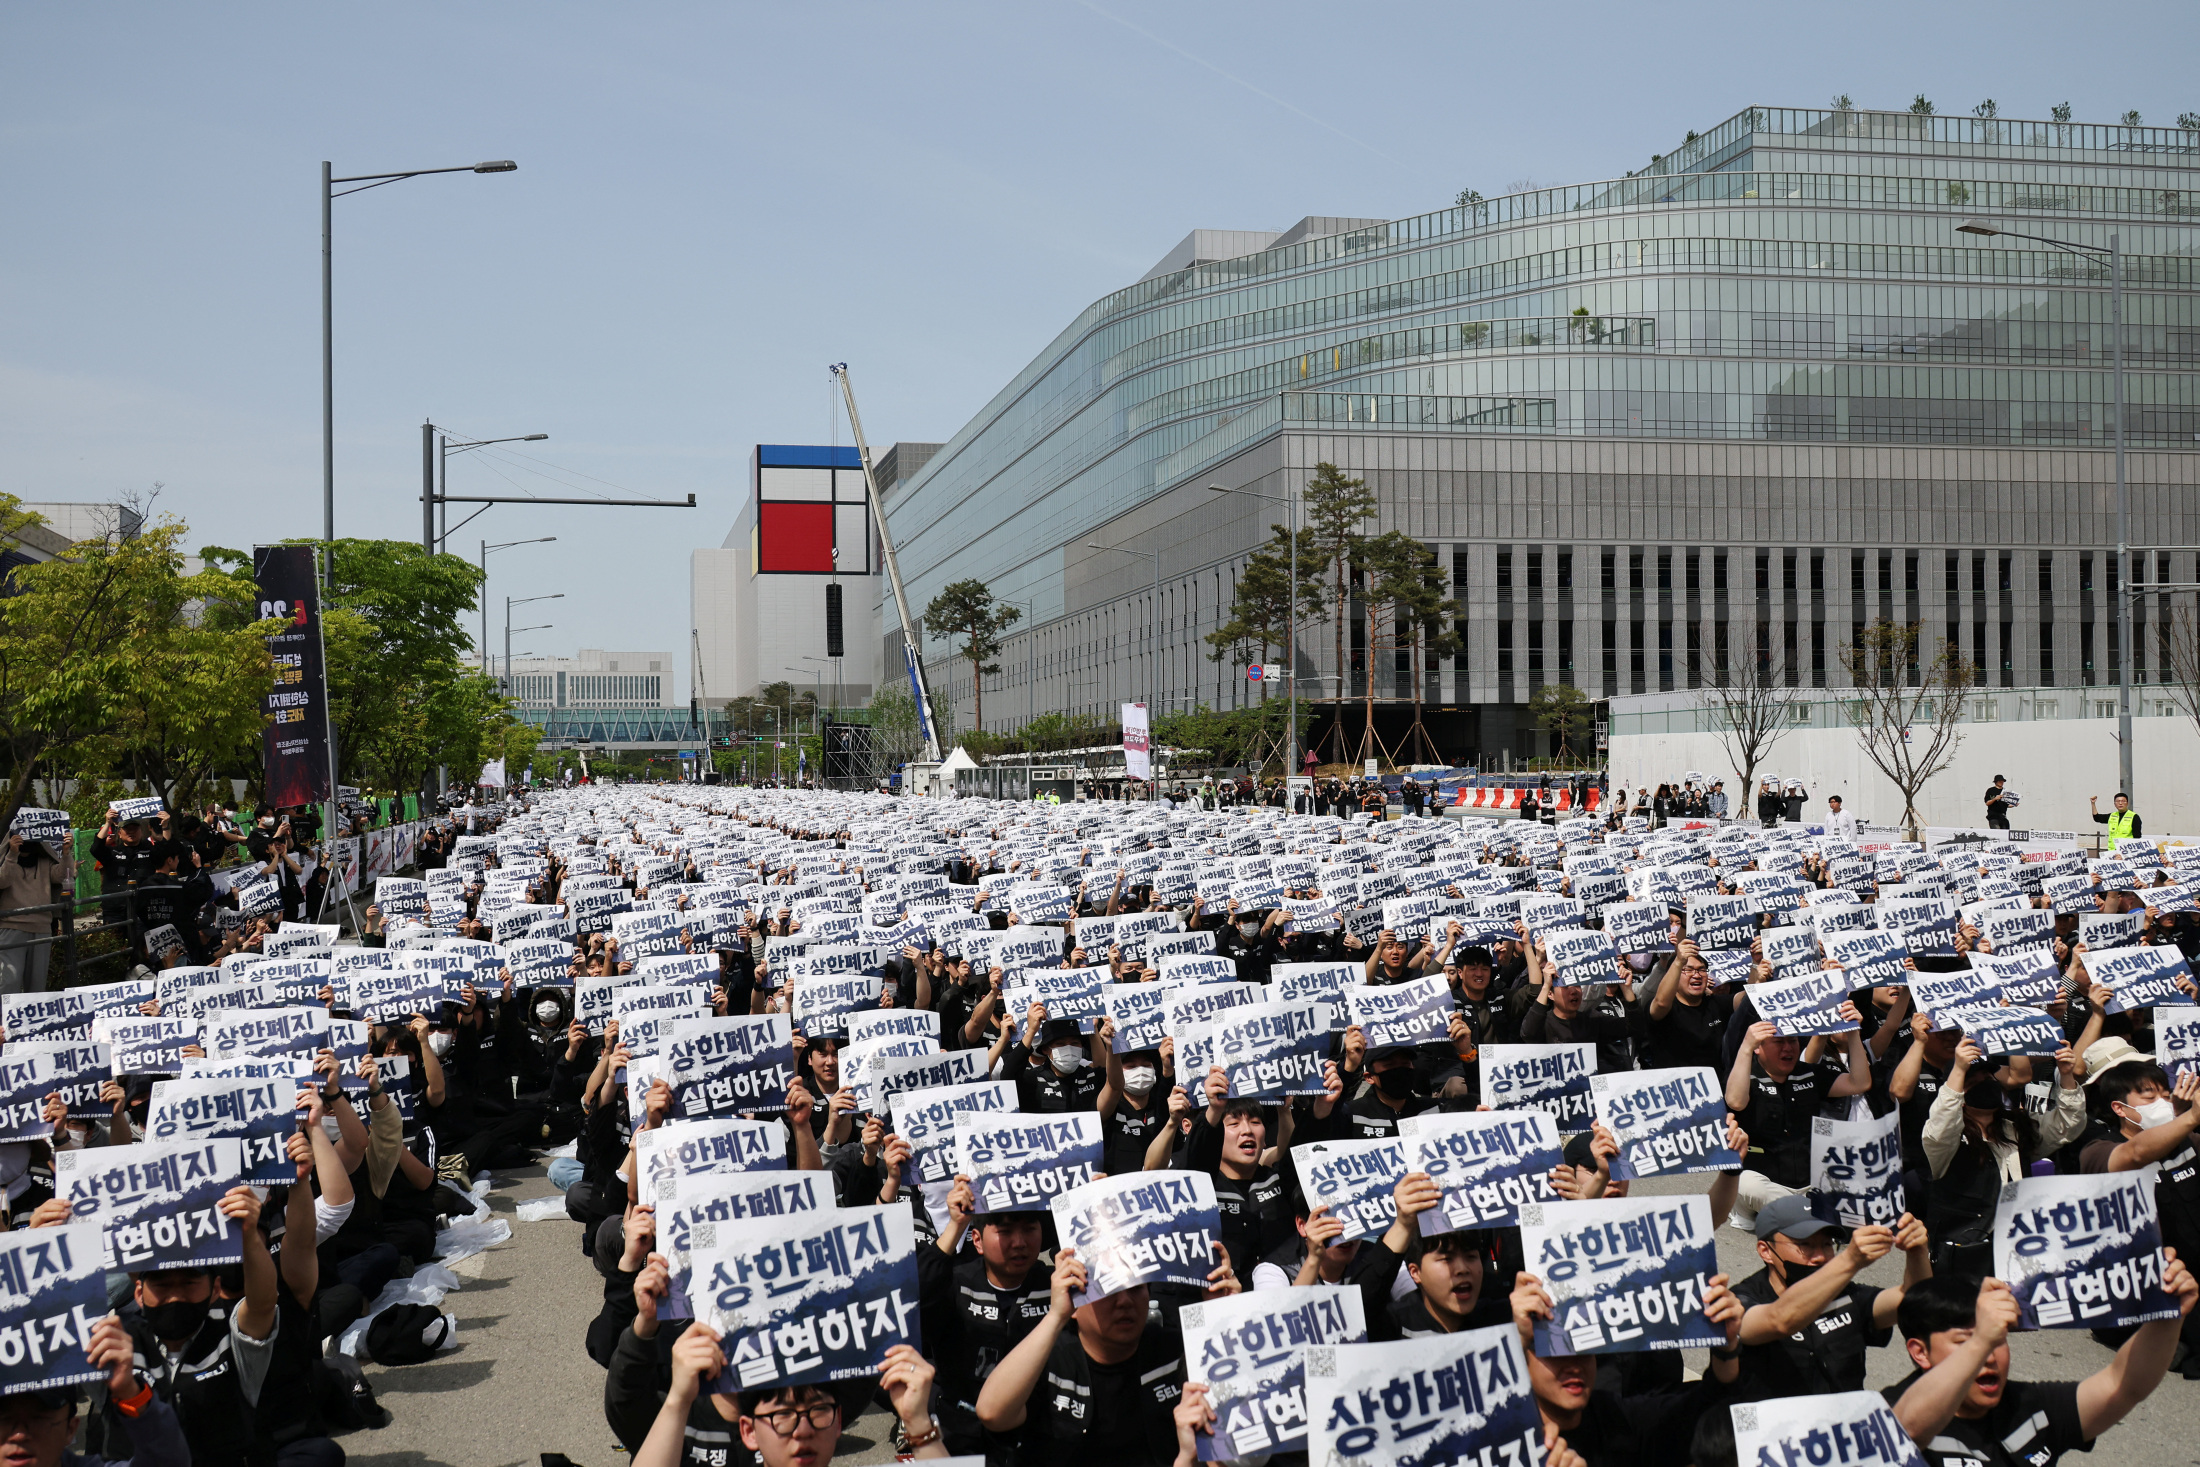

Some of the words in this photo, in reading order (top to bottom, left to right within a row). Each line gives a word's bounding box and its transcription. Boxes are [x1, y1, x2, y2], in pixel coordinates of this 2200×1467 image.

[16, 811, 62, 824] 상한폐지
[120, 804, 162, 819] 실현하자
[18, 825, 66, 841] 실현하자
[2010, 832, 2028, 840] NSEU
[2119, 840, 2152, 854] 상한폐지
[2094, 861, 2127, 875] 상한폐지
[241, 884, 274, 907] 상한폐지
[380, 882, 422, 896] 상한폐지
[900, 877, 946, 896] 상한폐지
[1014, 887, 1063, 909] 상한폐지
[1233, 881, 1276, 900] 상한폐지
[1580, 879, 1628, 899] 상한폐지
[1741, 875, 1793, 898] 상한폐지
[2048, 877, 2091, 898] 상한폐지
[382, 898, 425, 914] 실현하자
[574, 891, 629, 913] 상한폐지
[1020, 902, 1070, 924] 실현하자
[1285, 900, 1329, 918] 상한폐지
[1525, 898, 1579, 923] 상한폐지
[1692, 897, 1750, 924] 상한폐지
[496, 911, 543, 936] 상한폐지
[617, 914, 678, 937] 상한폐지
[809, 914, 865, 939] 상한폐지
[939, 915, 987, 937] 상한폐지
[1118, 914, 1169, 940] 상한폐지
[1291, 914, 1336, 932] 실현하자
[1609, 904, 1664, 930] 상한폐지
[1883, 902, 1947, 930] 상한폐지
[1989, 910, 2049, 939] 상한폐지
[863, 919, 916, 942] 상한폐지
[1617, 928, 1670, 953] 실현하자
[1697, 924, 1755, 950] 실현하자
[2084, 918, 2139, 942] 상한폐지
[508, 942, 573, 966] 상한폐지
[622, 937, 681, 961] 실현하자
[1000, 938, 1058, 963] 상한폐지
[1552, 935, 1609, 961] 상한폐지
[1765, 935, 1818, 960] 상한폐지
[1832, 934, 1896, 966] 상한폐지
[250, 959, 320, 984] 상한폐지
[810, 949, 879, 976] 상한폐지
[1560, 957, 1619, 986] 실현하자
[1849, 957, 1906, 988] 실현하자
[2096, 949, 2165, 984] 상한폐지
[159, 968, 221, 999] 상한폐지
[356, 971, 431, 998] 상한폐지
[513, 964, 568, 988] 실현하자
[1034, 969, 1102, 994] 상한폐지
[1279, 966, 1356, 1001] 상한폐지
[1915, 972, 1986, 1002] 상한폐지
[799, 978, 872, 1008] 상한폐지
[1354, 979, 1436, 1016] 상한폐지
[1758, 973, 1835, 1013] 상한폐지
[2116, 971, 2194, 1010] 실현하자
[6, 990, 86, 1029] 상한폐지
[1172, 986, 1255, 1024] 상한폐지
[214, 1009, 316, 1051] 상한폐지
[1220, 1007, 1315, 1055] 상한폐지
[1370, 1009, 1452, 1046] 실현하자
[1776, 1002, 1846, 1036] 실현하자
[668, 1018, 777, 1072] 상한폐지
[1982, 1021, 2063, 1053] 실현하자
[1231, 1049, 1328, 1096] 실현하자
[1488, 1048, 1586, 1093] 상한폐지
[680, 1063, 796, 1117] 실현하자
[1607, 1072, 1710, 1129] 상한폐지
[153, 1081, 277, 1137] 상한폐지
[966, 1117, 1084, 1163] 상한폐지
[1363, 1126, 1385, 1137] 투쟁
[647, 1126, 771, 1179] 상한폐지
[1417, 1116, 1544, 1177] 상한폐지
[1629, 1119, 1730, 1177] 실현하자
[70, 1144, 217, 1218] 상한폐지
[981, 1161, 1097, 1211] 실현하자
[2172, 1167, 2196, 1183] SELU
[1068, 1176, 1198, 1246] 상한폐지
[2007, 1178, 2150, 1258] 상한폐지
[1538, 1202, 1695, 1283] 상한폐지
[158, 1259, 206, 1270] 삼성전자노동조합
[207, 1256, 241, 1267] 공동투쟁본부
[708, 1212, 890, 1312] 상한폐지
[2030, 1246, 2170, 1328] 실현하자
[967, 1304, 999, 1320] 투쟁
[1563, 1271, 1713, 1352] 실현하자
[1816, 1312, 1852, 1335] SELU
[731, 1288, 921, 1389] 실현하자
[1200, 1292, 1349, 1383] 상한폐지
[1650, 1339, 1695, 1350] 삼성전자노동조합
[1696, 1337, 1727, 1348] 공동투쟁본부
[4, 1377, 64, 1394] 삼성전자노동조합
[1155, 1384, 1180, 1403] SEL
[1325, 1334, 1519, 1458] 상한폐지
[1053, 1394, 1085, 1419] 투쟁
[1226, 1385, 1308, 1456] 실현
[689, 1446, 726, 1467] 투쟁
